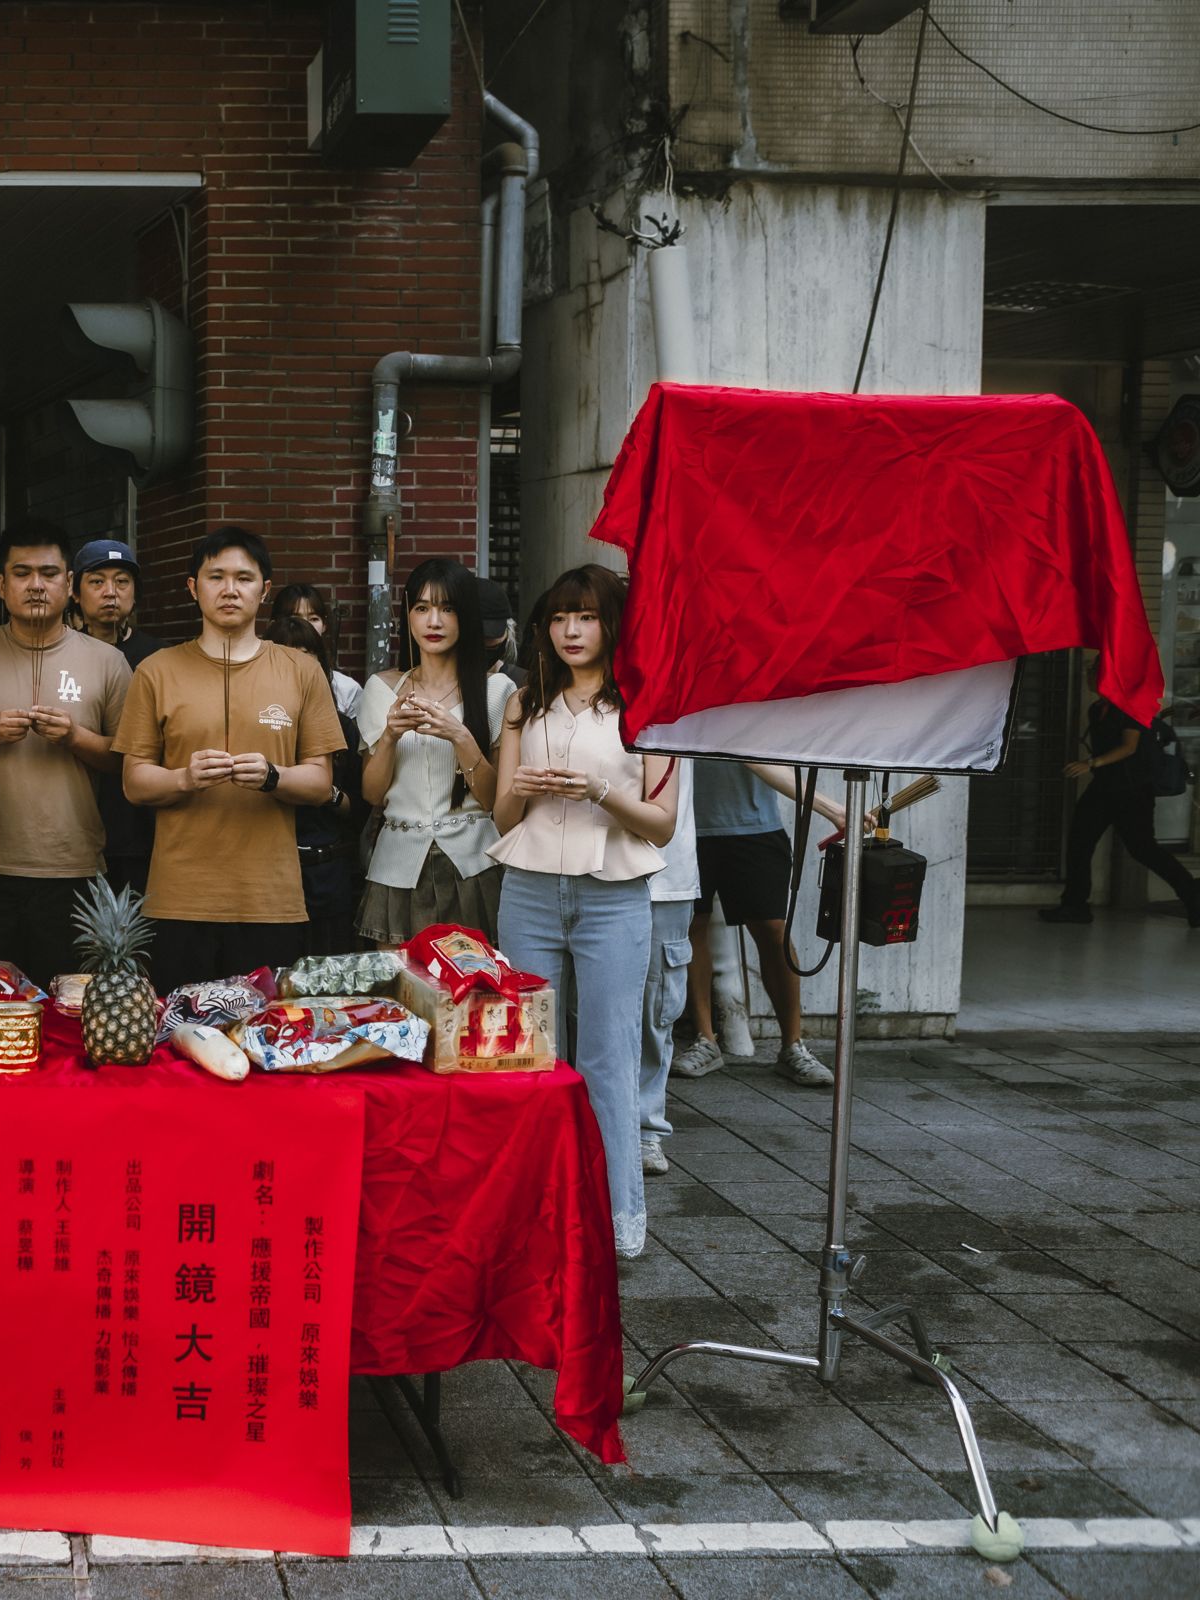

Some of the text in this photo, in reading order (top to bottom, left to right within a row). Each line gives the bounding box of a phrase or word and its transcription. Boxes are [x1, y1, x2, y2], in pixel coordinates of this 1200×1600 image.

[57, 670, 82, 702] LA
[539, 1019, 548, 1032] 6
[540, 999, 549, 1012] 5
[18, 1158, 35, 1195] 導演
[125, 1159, 142, 1232] 出品公司
[123, 1249, 140, 1322] 原來娛樂
[172, 1203, 217, 1422] 開鏡大吉
[298, 1215, 324, 1411] 製作公司 原來娛樂
